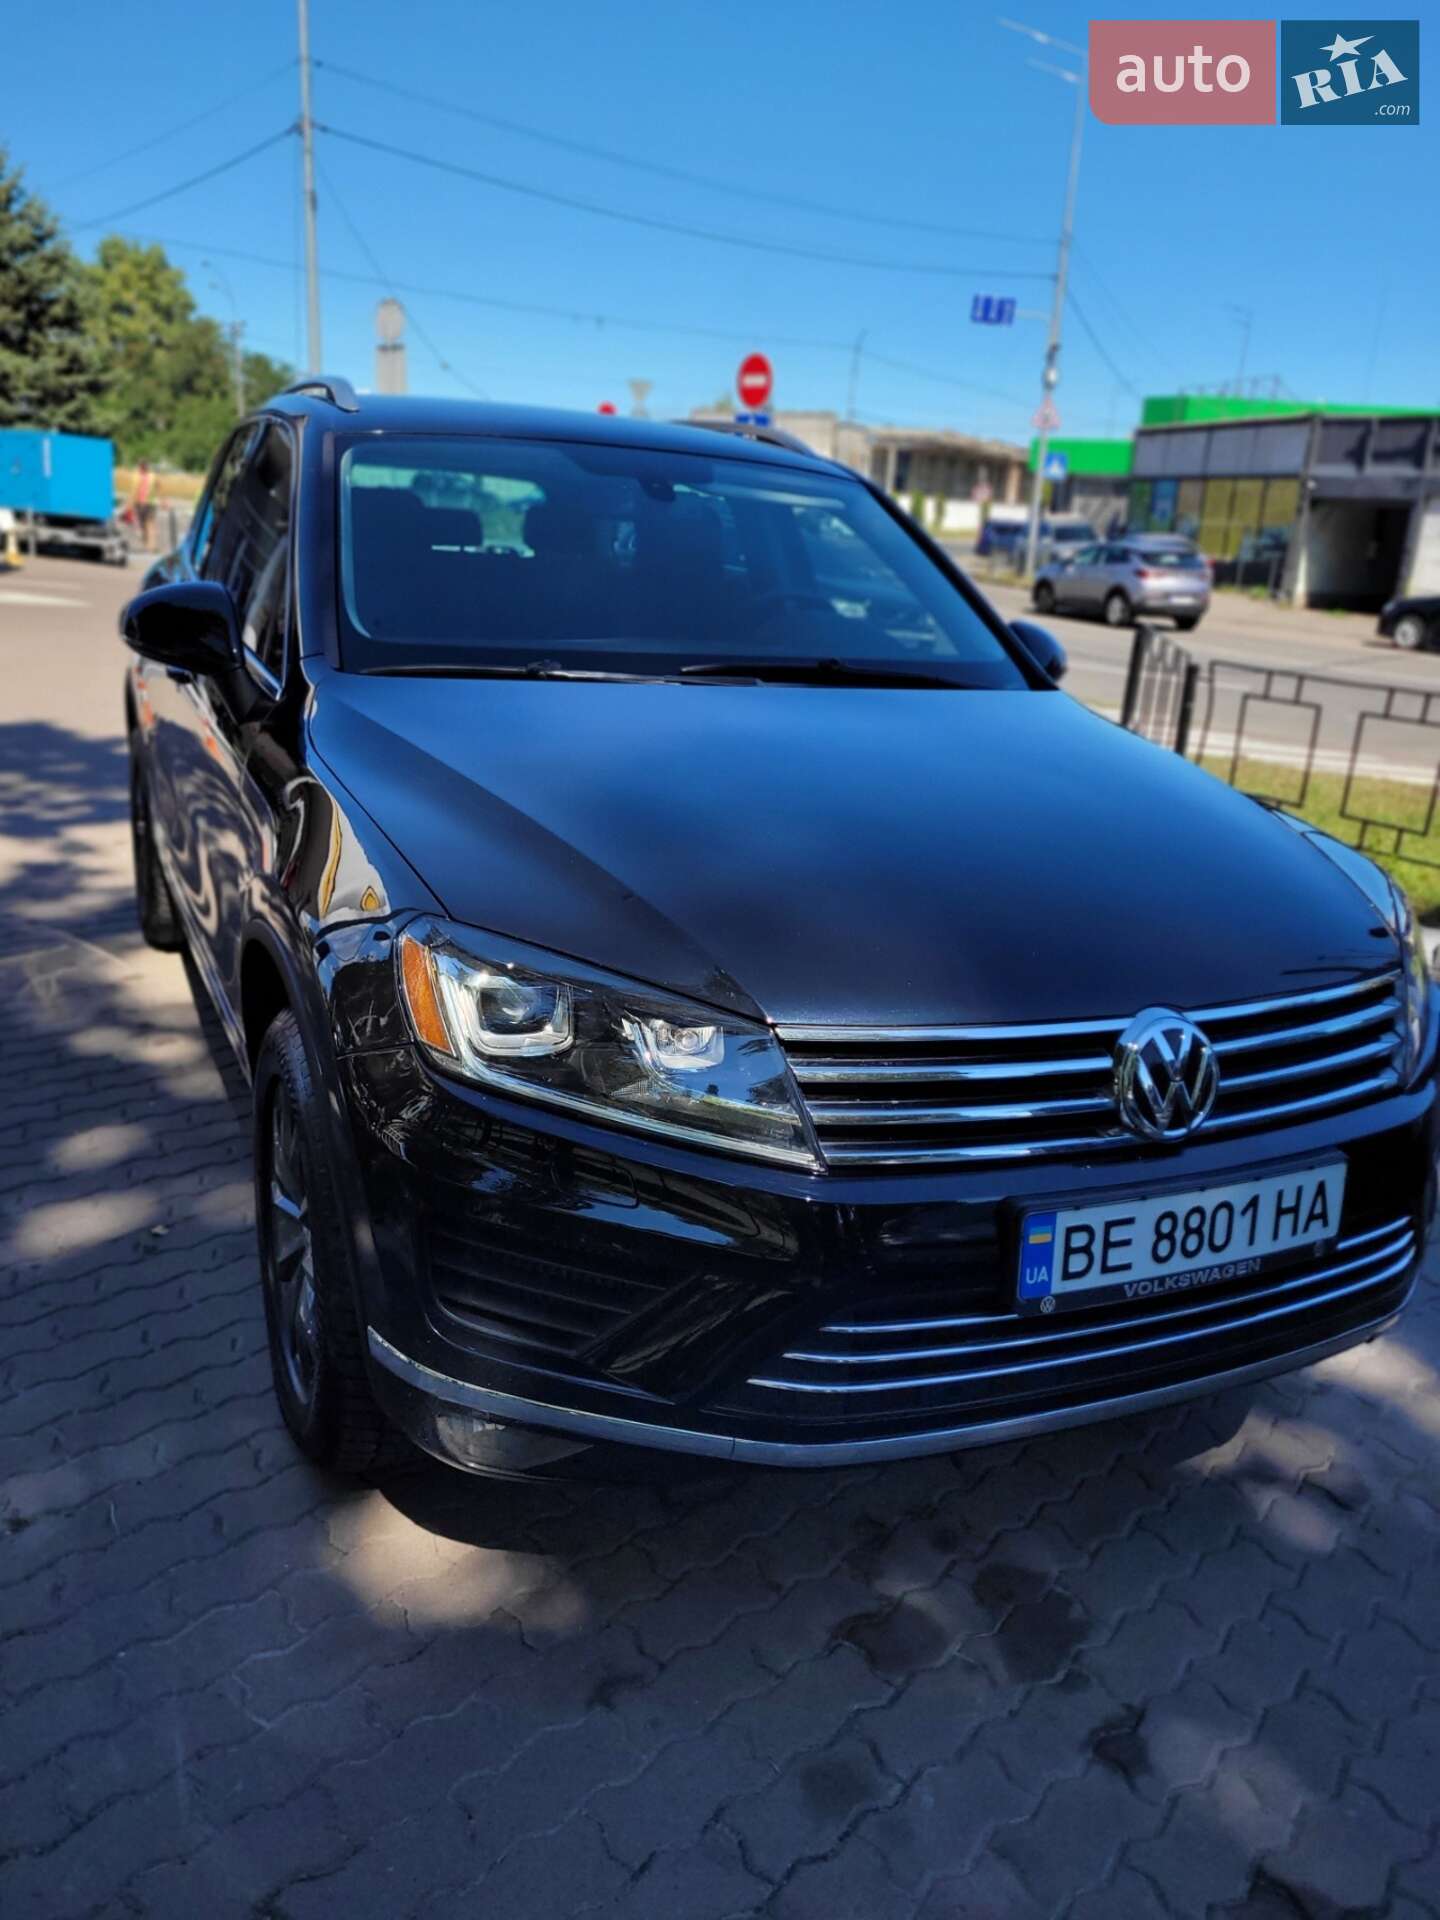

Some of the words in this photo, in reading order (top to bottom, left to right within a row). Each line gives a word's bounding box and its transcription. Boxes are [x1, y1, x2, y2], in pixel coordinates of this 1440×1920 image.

[1060, 1215, 1136, 1281] BE
[1151, 1193, 1260, 1264] 8801
[1273, 1178, 1330, 1242] HA
[1026, 1265, 1049, 1285] UA
[1123, 1257, 1262, 1298] VOLKSWAGEN
